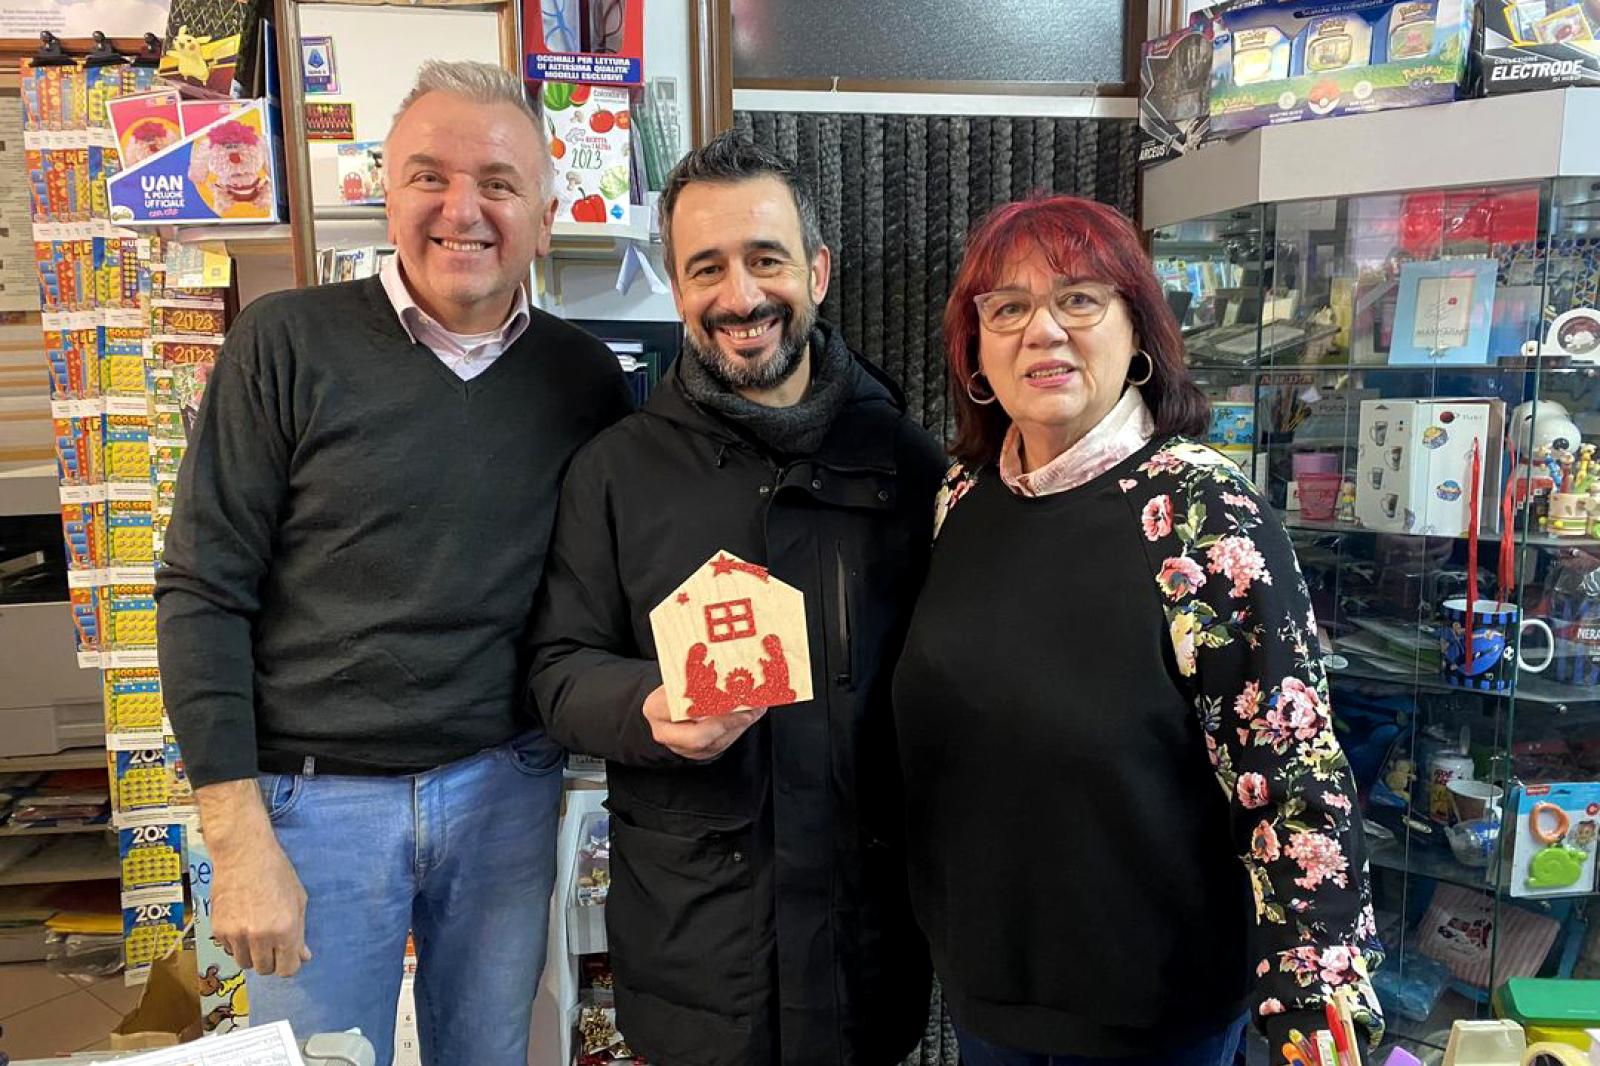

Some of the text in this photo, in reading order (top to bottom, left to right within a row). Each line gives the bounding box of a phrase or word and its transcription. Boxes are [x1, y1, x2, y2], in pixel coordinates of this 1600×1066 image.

[536, 55, 630, 66] OCCHIALI PER LETTURA
[548, 64, 592, 72] ALTISSIMA
[545, 71, 623, 81] MODELLI ESCLUSIVI
[1491, 59, 1585, 81] ELECTRODE
[571, 148, 603, 169] 2023
[141, 174, 183, 192] UAN
[144, 199, 185, 208] UFFICIALE
[172, 310, 214, 331] 2023
[173, 346, 215, 364] 2023
